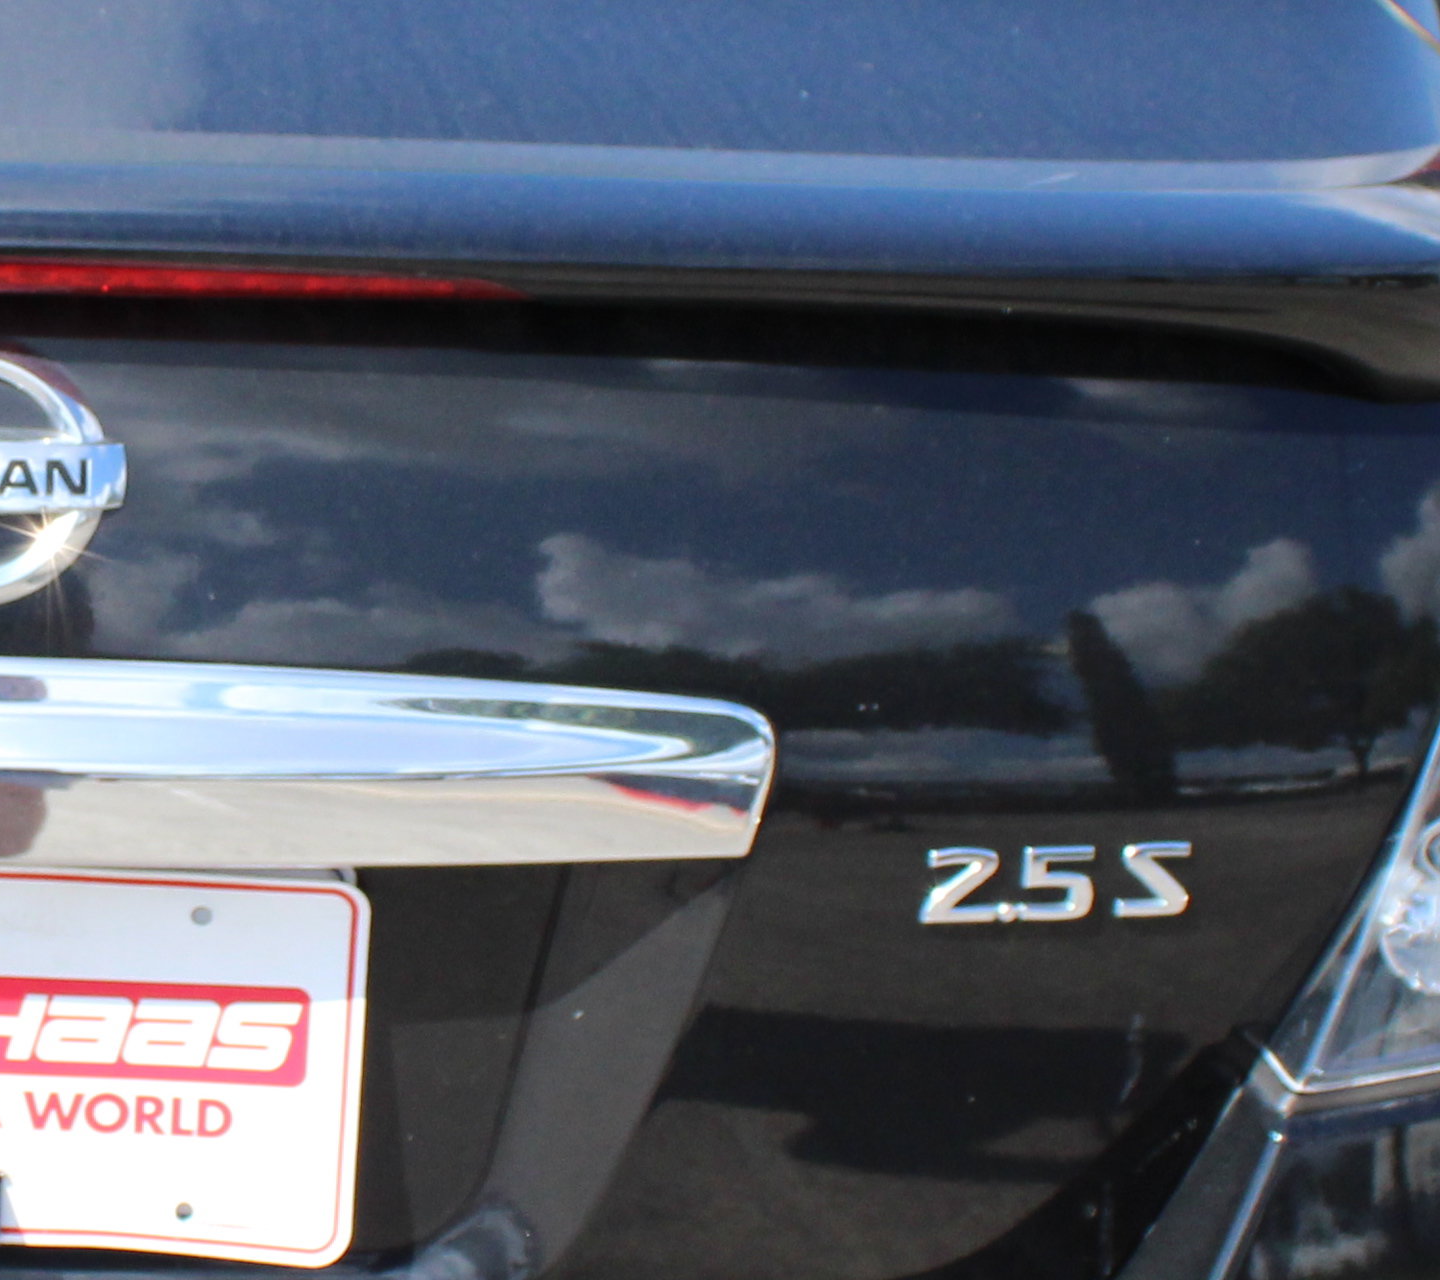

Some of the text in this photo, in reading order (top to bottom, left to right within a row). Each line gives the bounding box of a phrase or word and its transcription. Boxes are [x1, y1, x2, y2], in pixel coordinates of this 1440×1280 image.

[918, 840, 1192, 924] 2.5 S
[23, 1090, 233, 1138] WORLD
